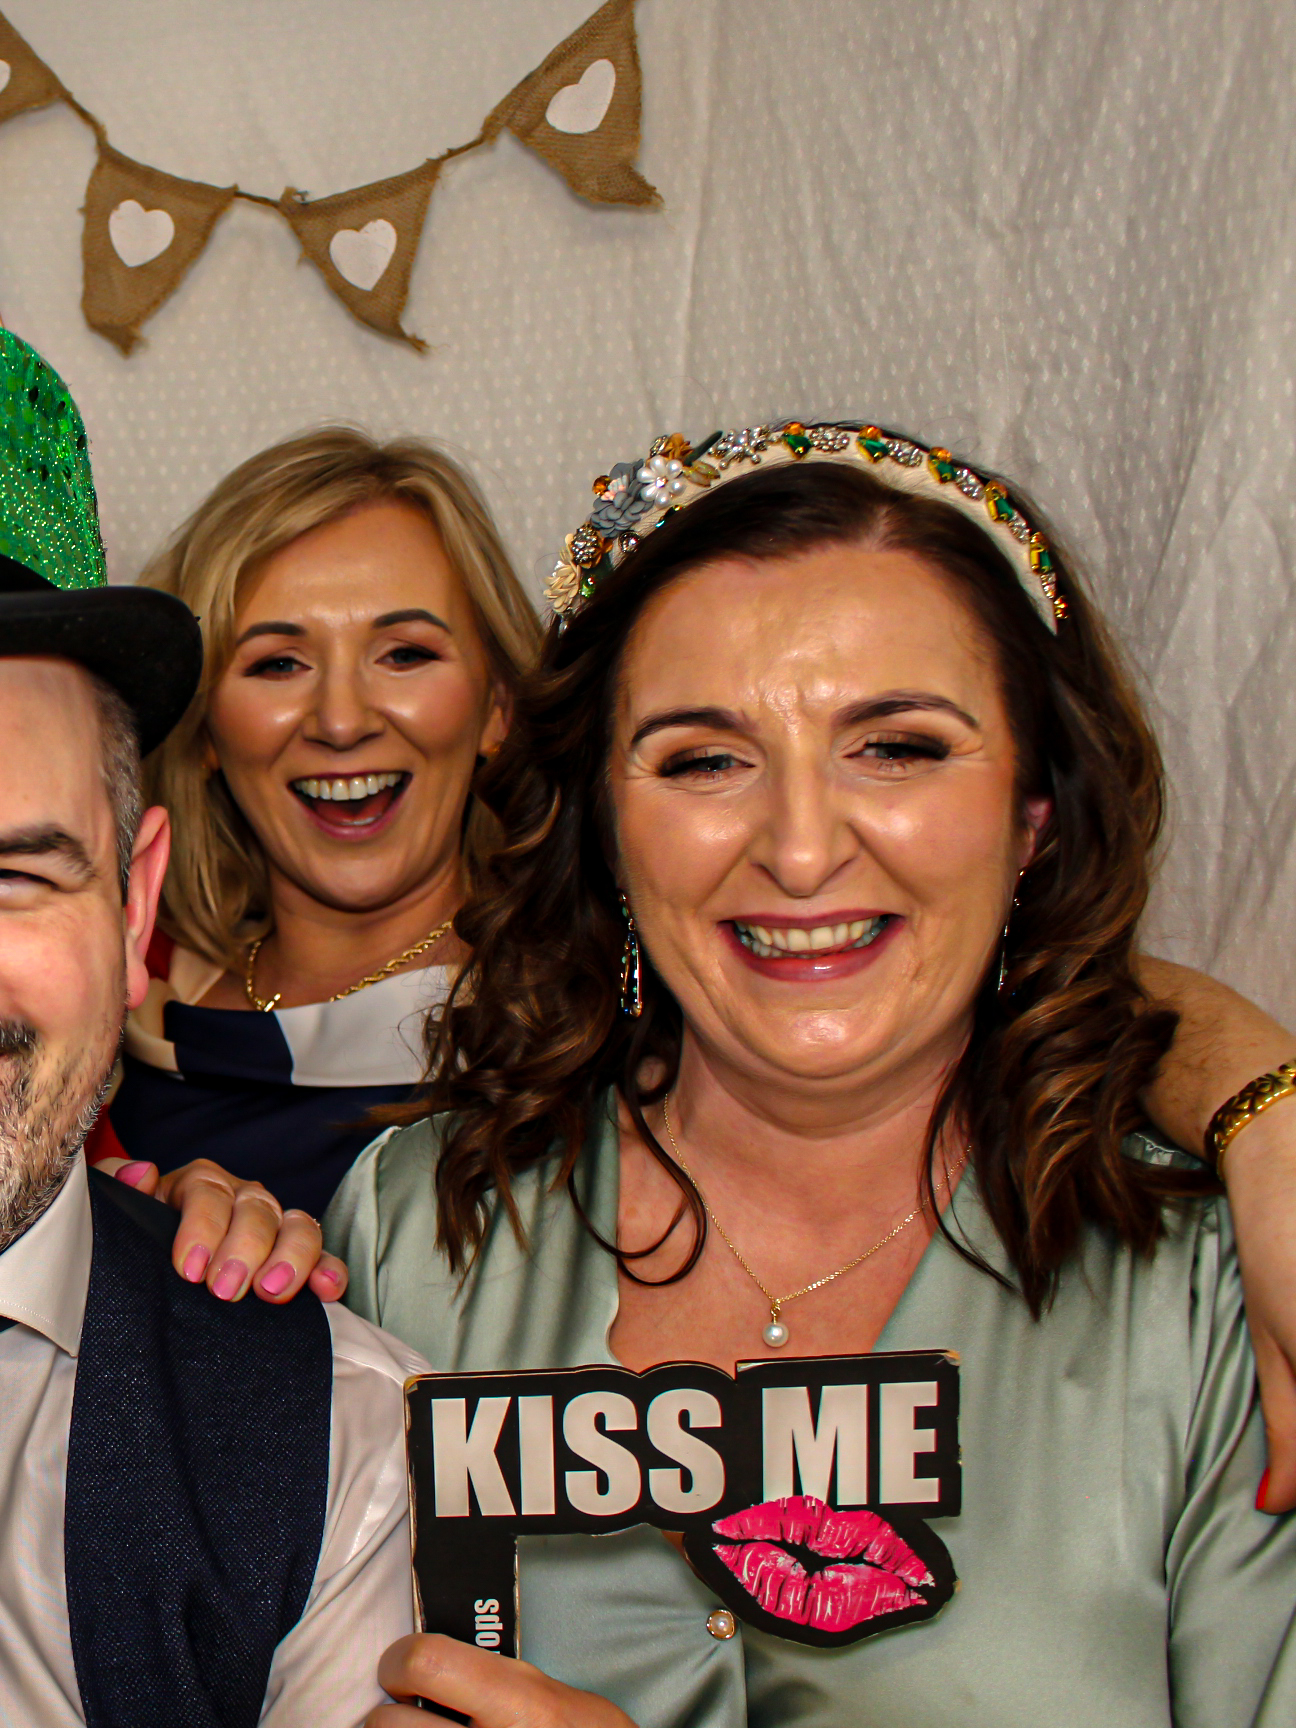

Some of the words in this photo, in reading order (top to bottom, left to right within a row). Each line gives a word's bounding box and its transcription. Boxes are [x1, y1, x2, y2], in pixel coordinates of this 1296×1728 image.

[431, 1388, 725, 1518] KISS
[761, 1381, 939, 1505] ME
[474, 1598, 502, 1654] ops
